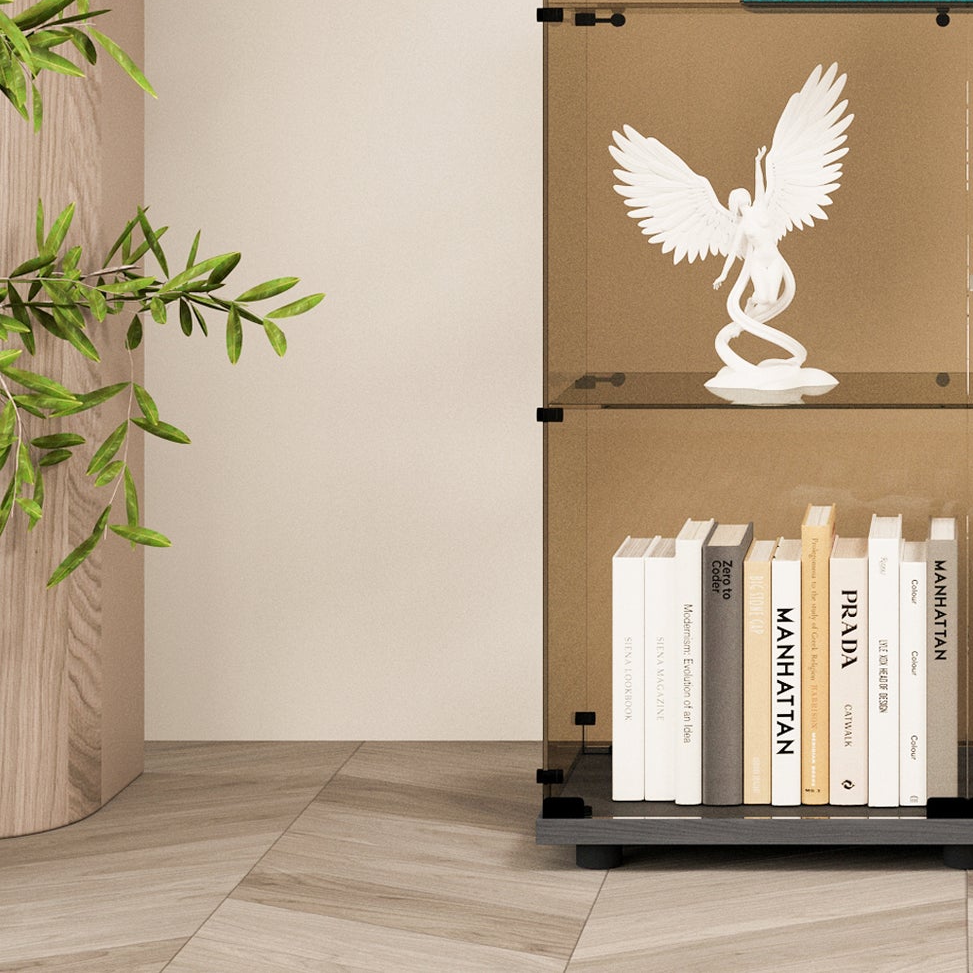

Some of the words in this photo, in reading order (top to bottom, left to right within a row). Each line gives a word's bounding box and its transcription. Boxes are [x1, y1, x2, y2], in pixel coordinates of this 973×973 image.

[712, 560, 722, 593] Coder
[723, 560, 733, 586] Zero
[811, 581, 818, 589] to
[723, 588, 732, 600] to
[811, 590, 819, 601] the
[911, 579, 919, 604] Colour
[809, 603, 819, 620] study
[935, 560, 947, 660] MANHATTAN
[684, 603, 694, 655] Modernism:
[811, 622, 819, 630] of
[842, 590, 858, 669] PRADA
[624, 636, 633, 665] SIENA
[656, 636, 665, 665] SIENA
[811, 631, 819, 651] Greek
[809, 654, 819, 681] Religion
[879, 668, 888, 682] HEAD
[911, 650, 919, 676] Colour
[684, 658, 694, 698] Evolution
[776, 608, 794, 755] MANHATTAN
[624, 668, 633, 722] LOOKBOOK
[656, 668, 665, 722] MAGAZINE
[684, 700, 694, 709] of
[879, 692, 888, 713] DESIGN
[684, 711, 692, 722] an
[844, 704, 852, 747] CATWALK
[684, 724, 694, 744] Idea
[911, 734, 919, 760] Colour
